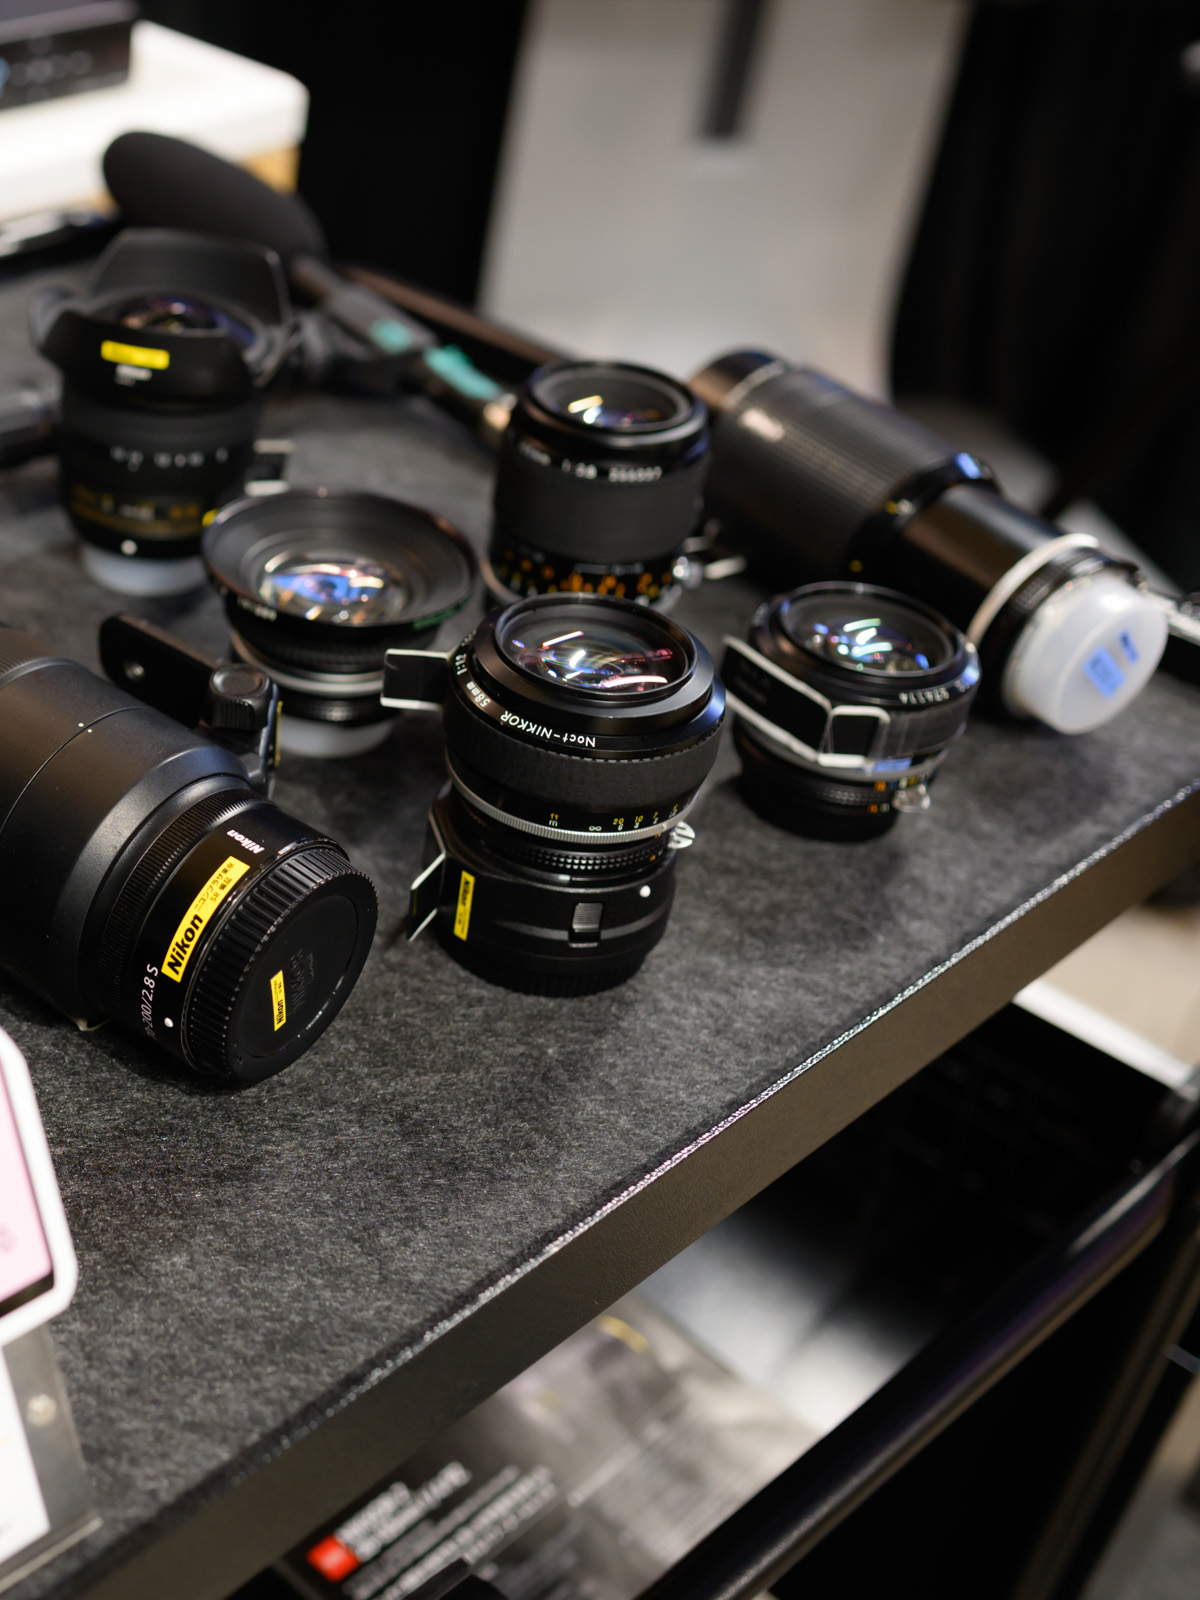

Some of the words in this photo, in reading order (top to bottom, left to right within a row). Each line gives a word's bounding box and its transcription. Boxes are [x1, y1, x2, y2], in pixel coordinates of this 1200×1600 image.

[466, 680, 491, 707] 58mm
[500, 709, 596, 748] Noct-NIKKOR
[634, 815, 644, 823] 10
[227, 829, 265, 854] Nikon
[194, 861, 235, 911] ニコンプラザ東京
[210, 891, 221, 903] SR
[167, 913, 203, 976] Nikon
[147, 963, 159, 977] S
[276, 999, 285, 1026] Nikon
